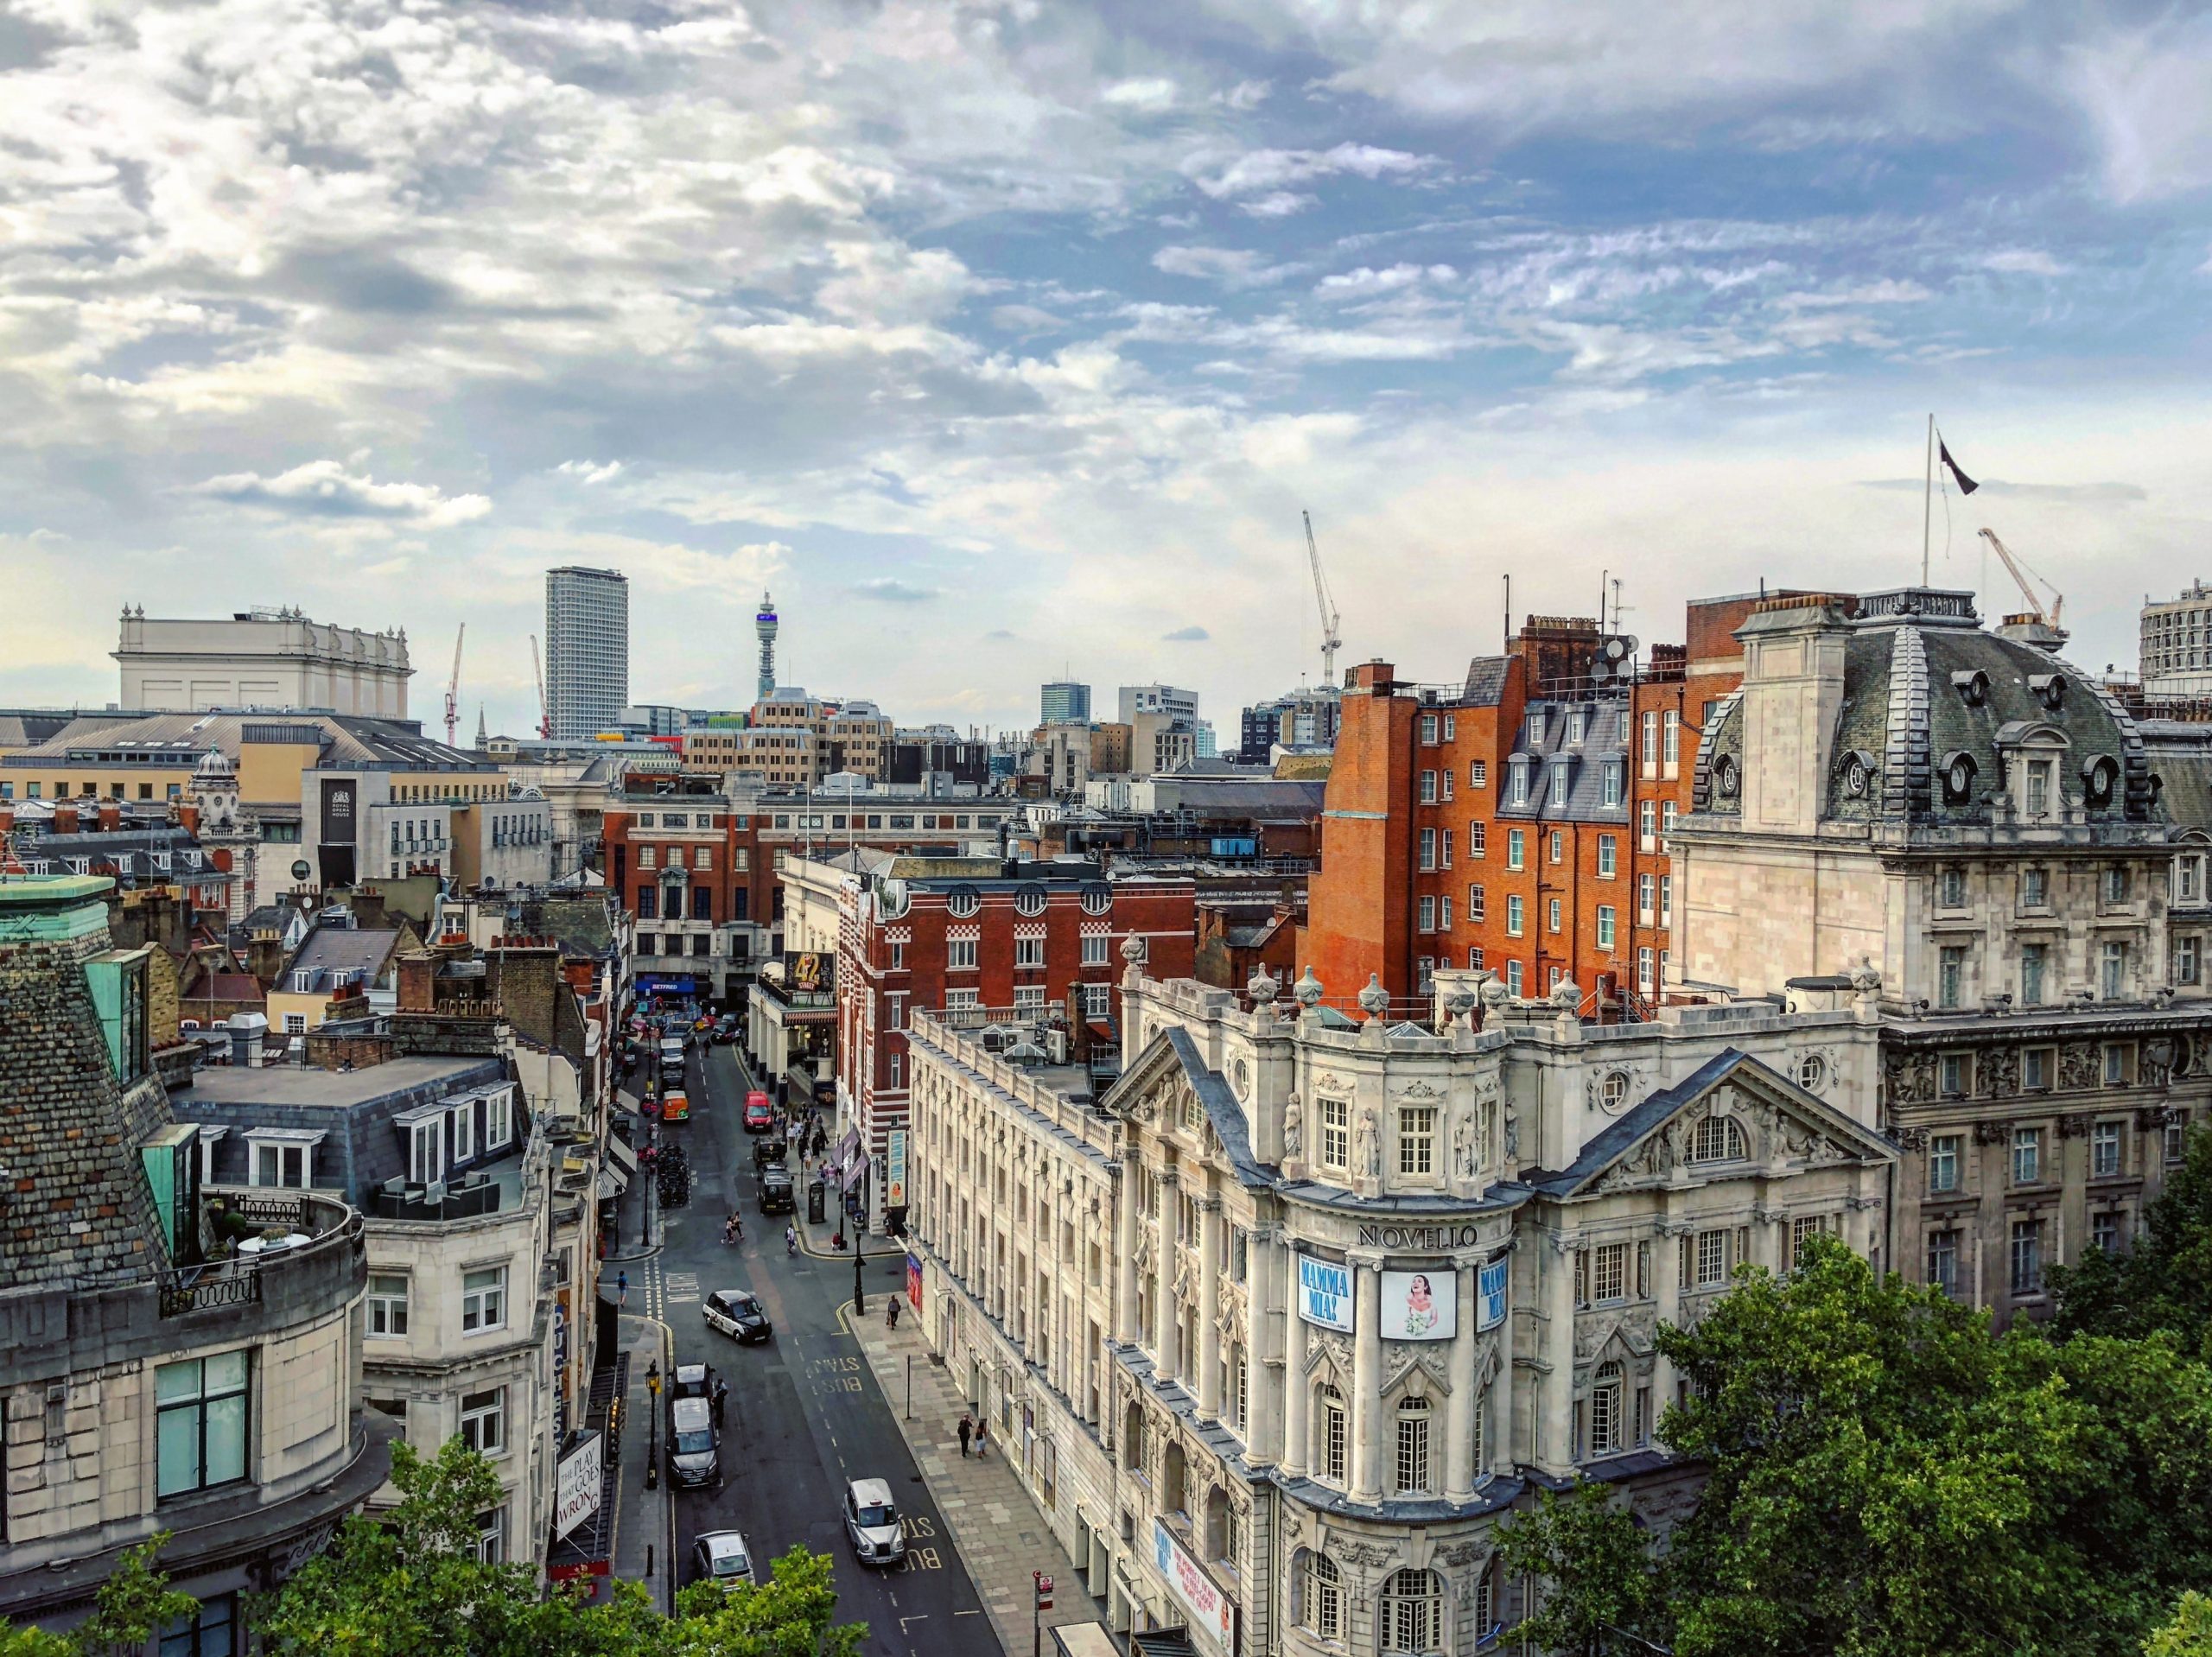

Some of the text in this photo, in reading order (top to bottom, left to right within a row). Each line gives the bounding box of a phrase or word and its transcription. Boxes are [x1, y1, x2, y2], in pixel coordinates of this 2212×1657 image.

[1357, 1225, 1479, 1249] NOVELLO
[1301, 1260, 1349, 1298] MAMMA
[1308, 1289, 1338, 1322] MIA!
[553, 1311, 564, 1456] DUCHESS
[822, 1376, 862, 1394] BUS
[559, 1461, 600, 1504] THAT GOES
[561, 1447, 595, 1485] THE PLAY
[558, 1486, 598, 1524] WRONG
[900, 1517, 935, 1539] STA
